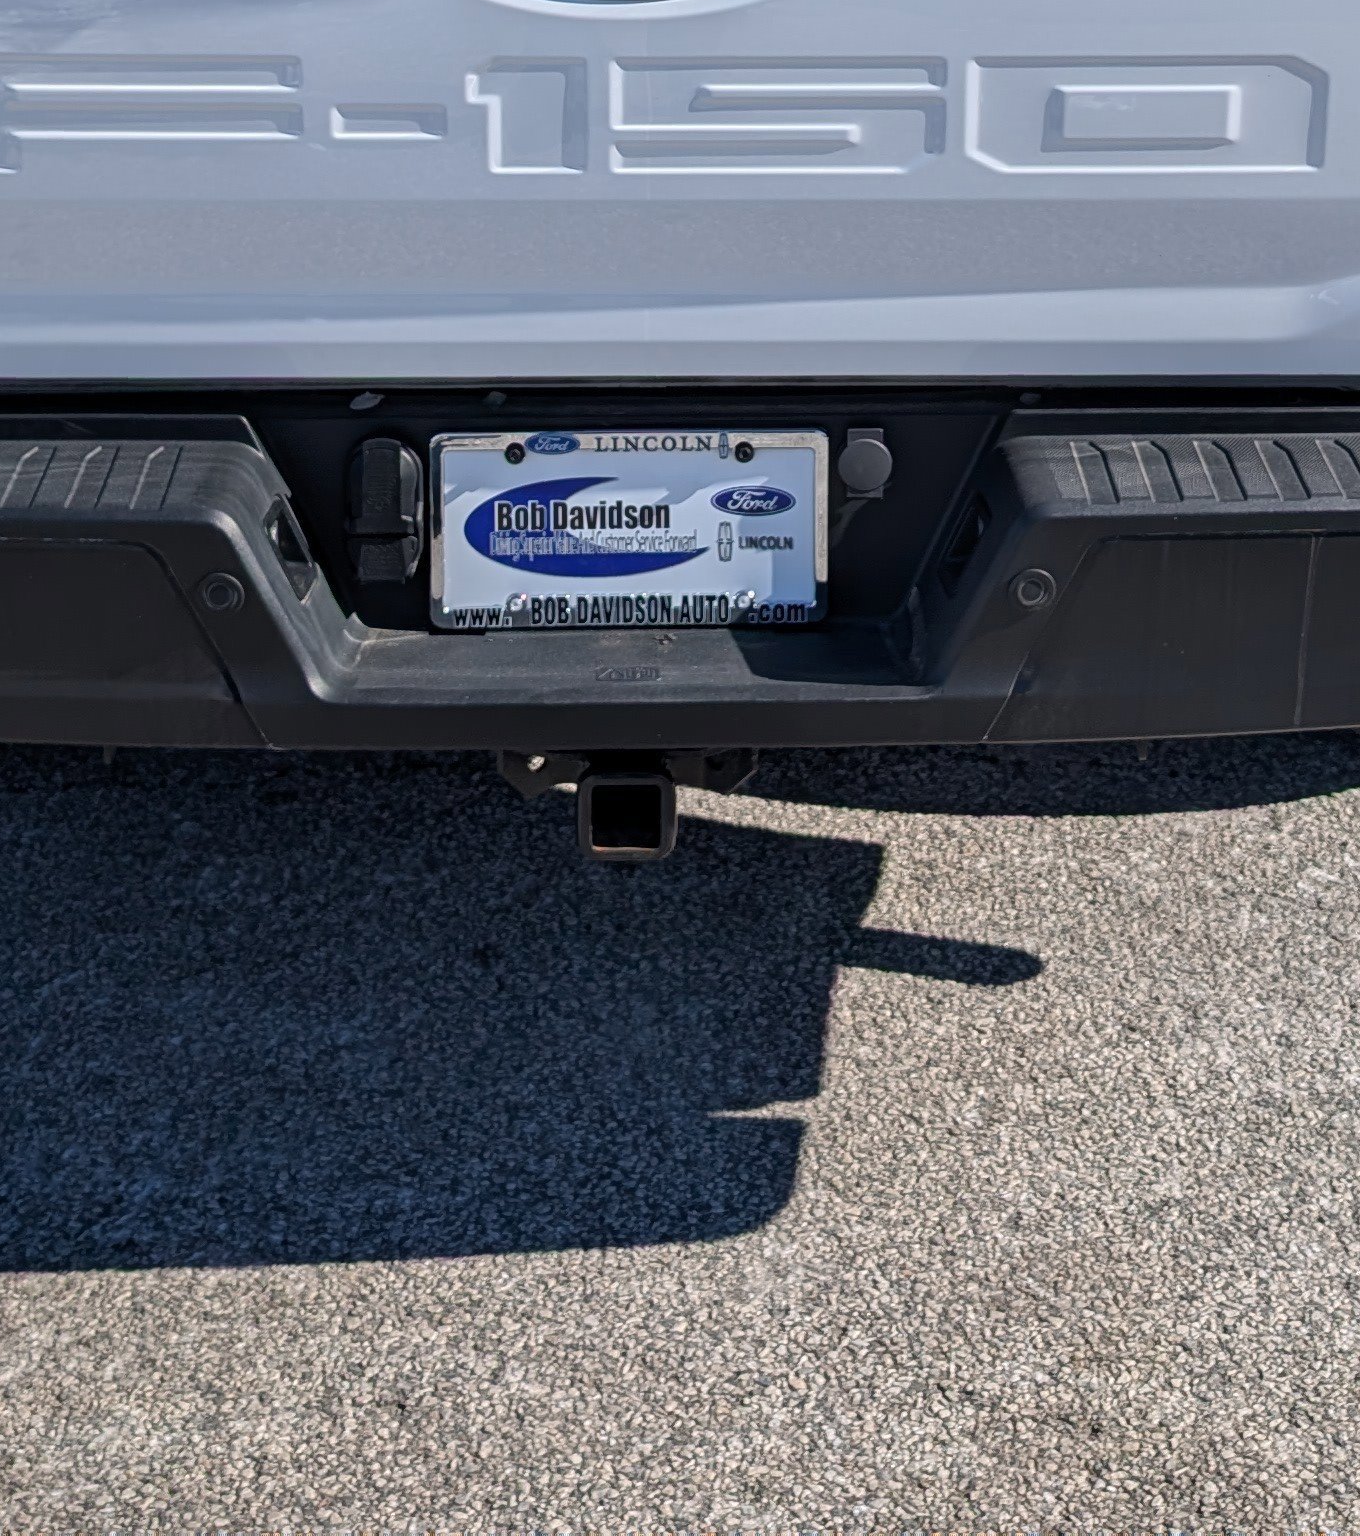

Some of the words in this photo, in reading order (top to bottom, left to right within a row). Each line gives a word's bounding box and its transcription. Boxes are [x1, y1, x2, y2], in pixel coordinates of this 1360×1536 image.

[535, 436, 569, 452] Ford
[594, 436, 712, 453] LINCOLN
[727, 490, 778, 511] Ford
[495, 500, 546, 531] Bob
[552, 500, 670, 530] Davidson
[739, 536, 794, 550] LINCOLN
[454, 608, 512, 626] www.
[531, 596, 568, 625] BOB
[577, 595, 673, 624] DAVIDSON
[680, 594, 730, 623] AUTO
[747, 602, 807, 624] .com
